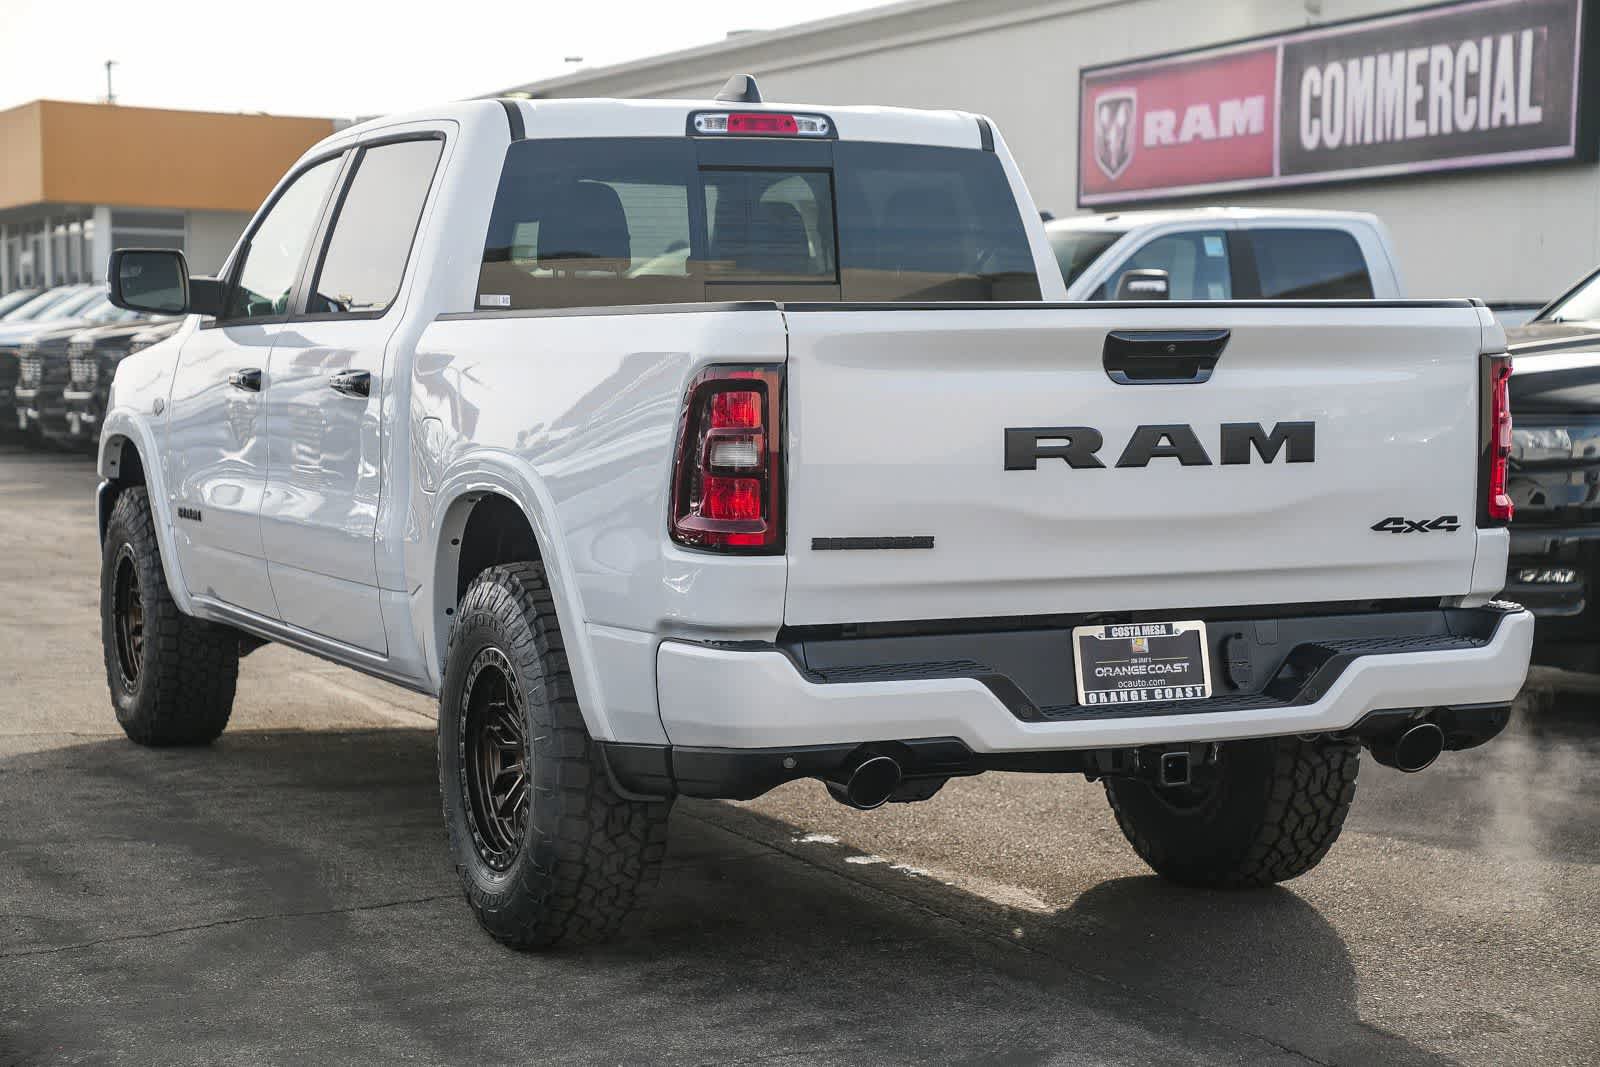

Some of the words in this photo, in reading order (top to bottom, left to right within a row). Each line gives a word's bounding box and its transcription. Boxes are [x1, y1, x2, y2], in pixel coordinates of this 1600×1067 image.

[1143, 95, 1265, 148] RAM
[1300, 28, 1542, 151] COMMERCIAL
[1003, 421, 1316, 471] RAM
[1370, 515, 1461, 534] 4x4
[1111, 625, 1141, 637] COSTA
[1141, 624, 1167, 636] MESA
[1118, 678, 1166, 688] ocauto.com
[1088, 688, 1148, 704] ORANGE
[1154, 686, 1203, 699] COAST
